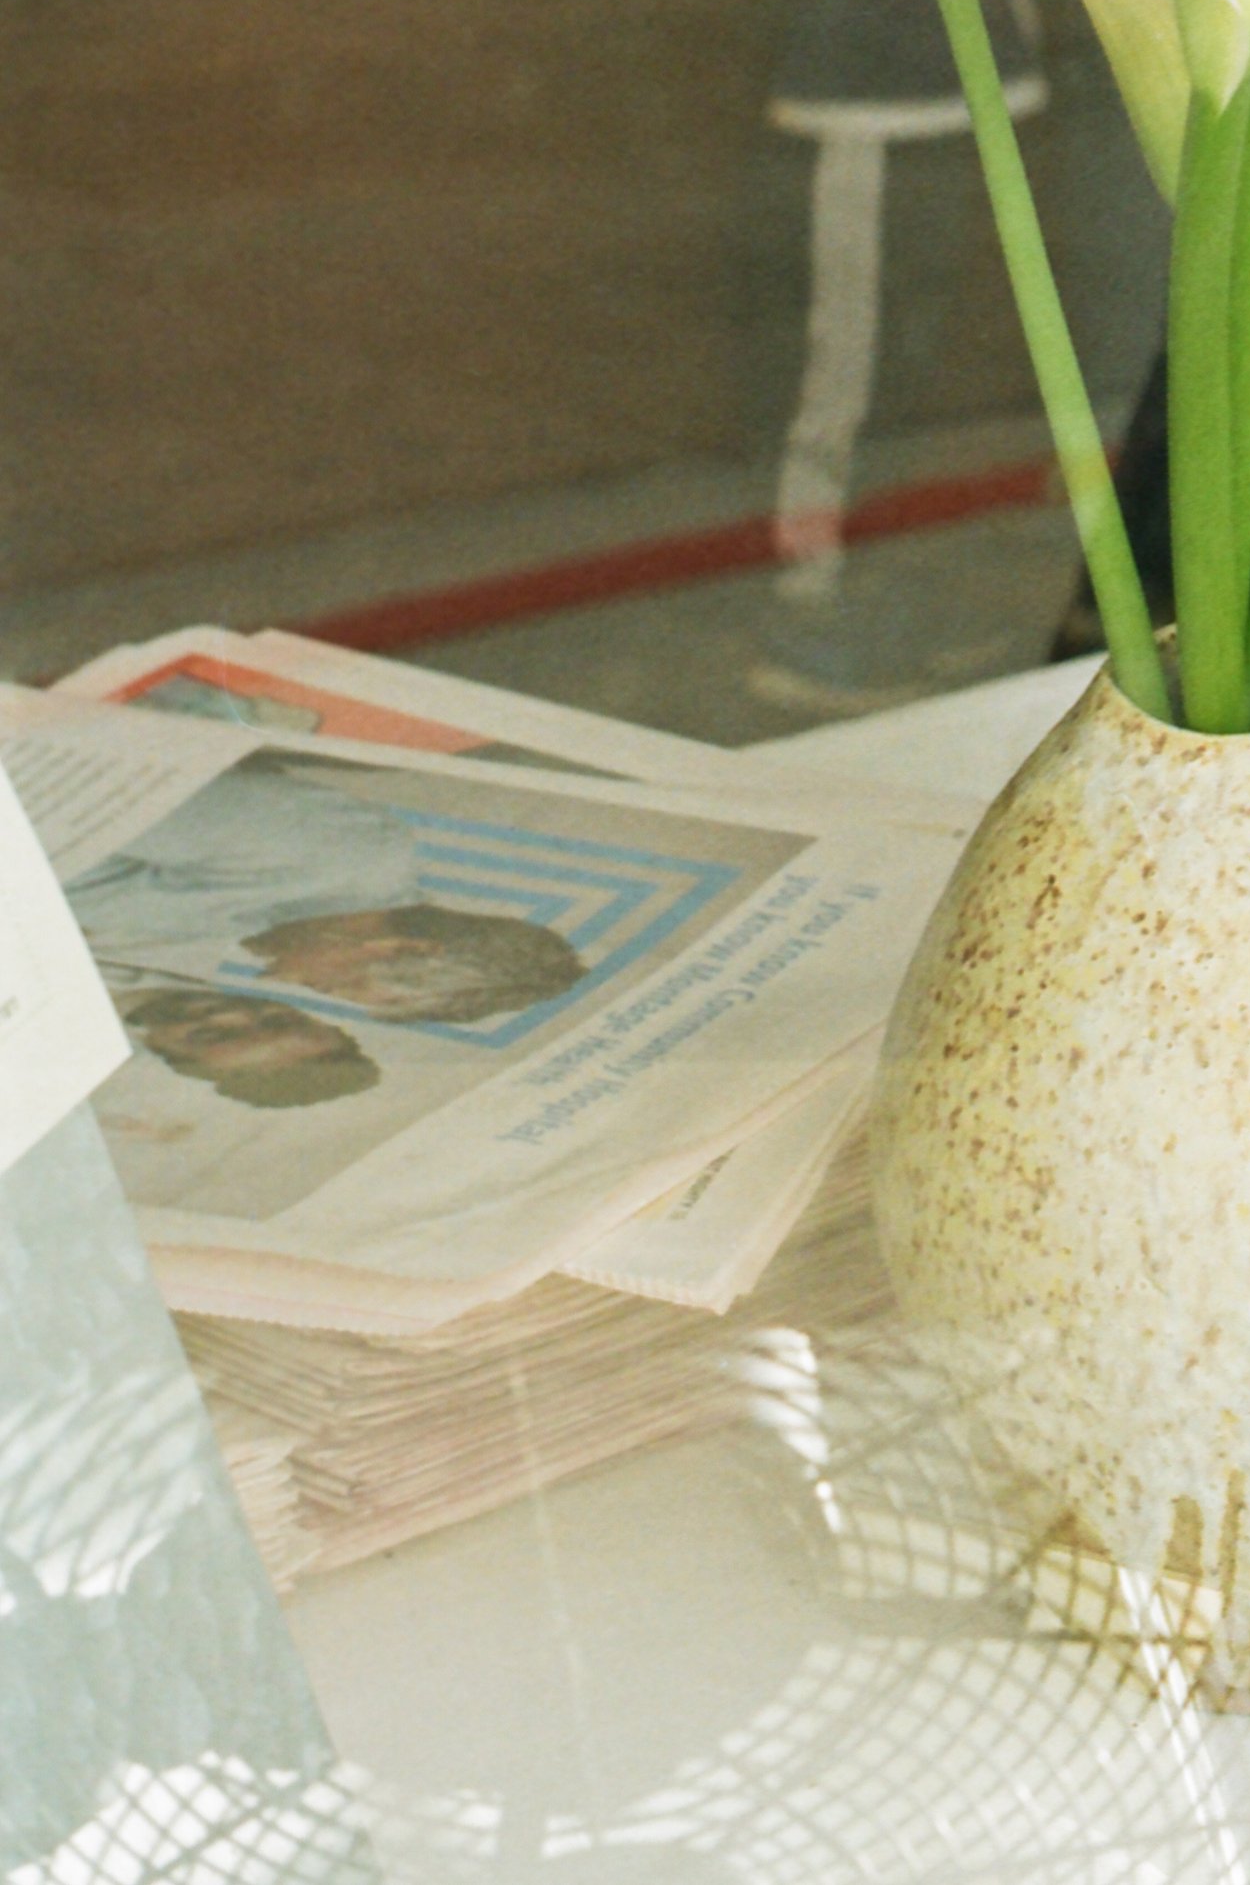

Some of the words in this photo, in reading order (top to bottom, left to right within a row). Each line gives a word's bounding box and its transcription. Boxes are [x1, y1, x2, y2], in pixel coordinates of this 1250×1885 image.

[767, 872, 823, 909] you
[842, 882, 882, 902] If
[705, 907, 788, 963] know
[800, 900, 853, 937] you
[740, 935, 824, 987] know
[602, 987, 757, 1078] Community
